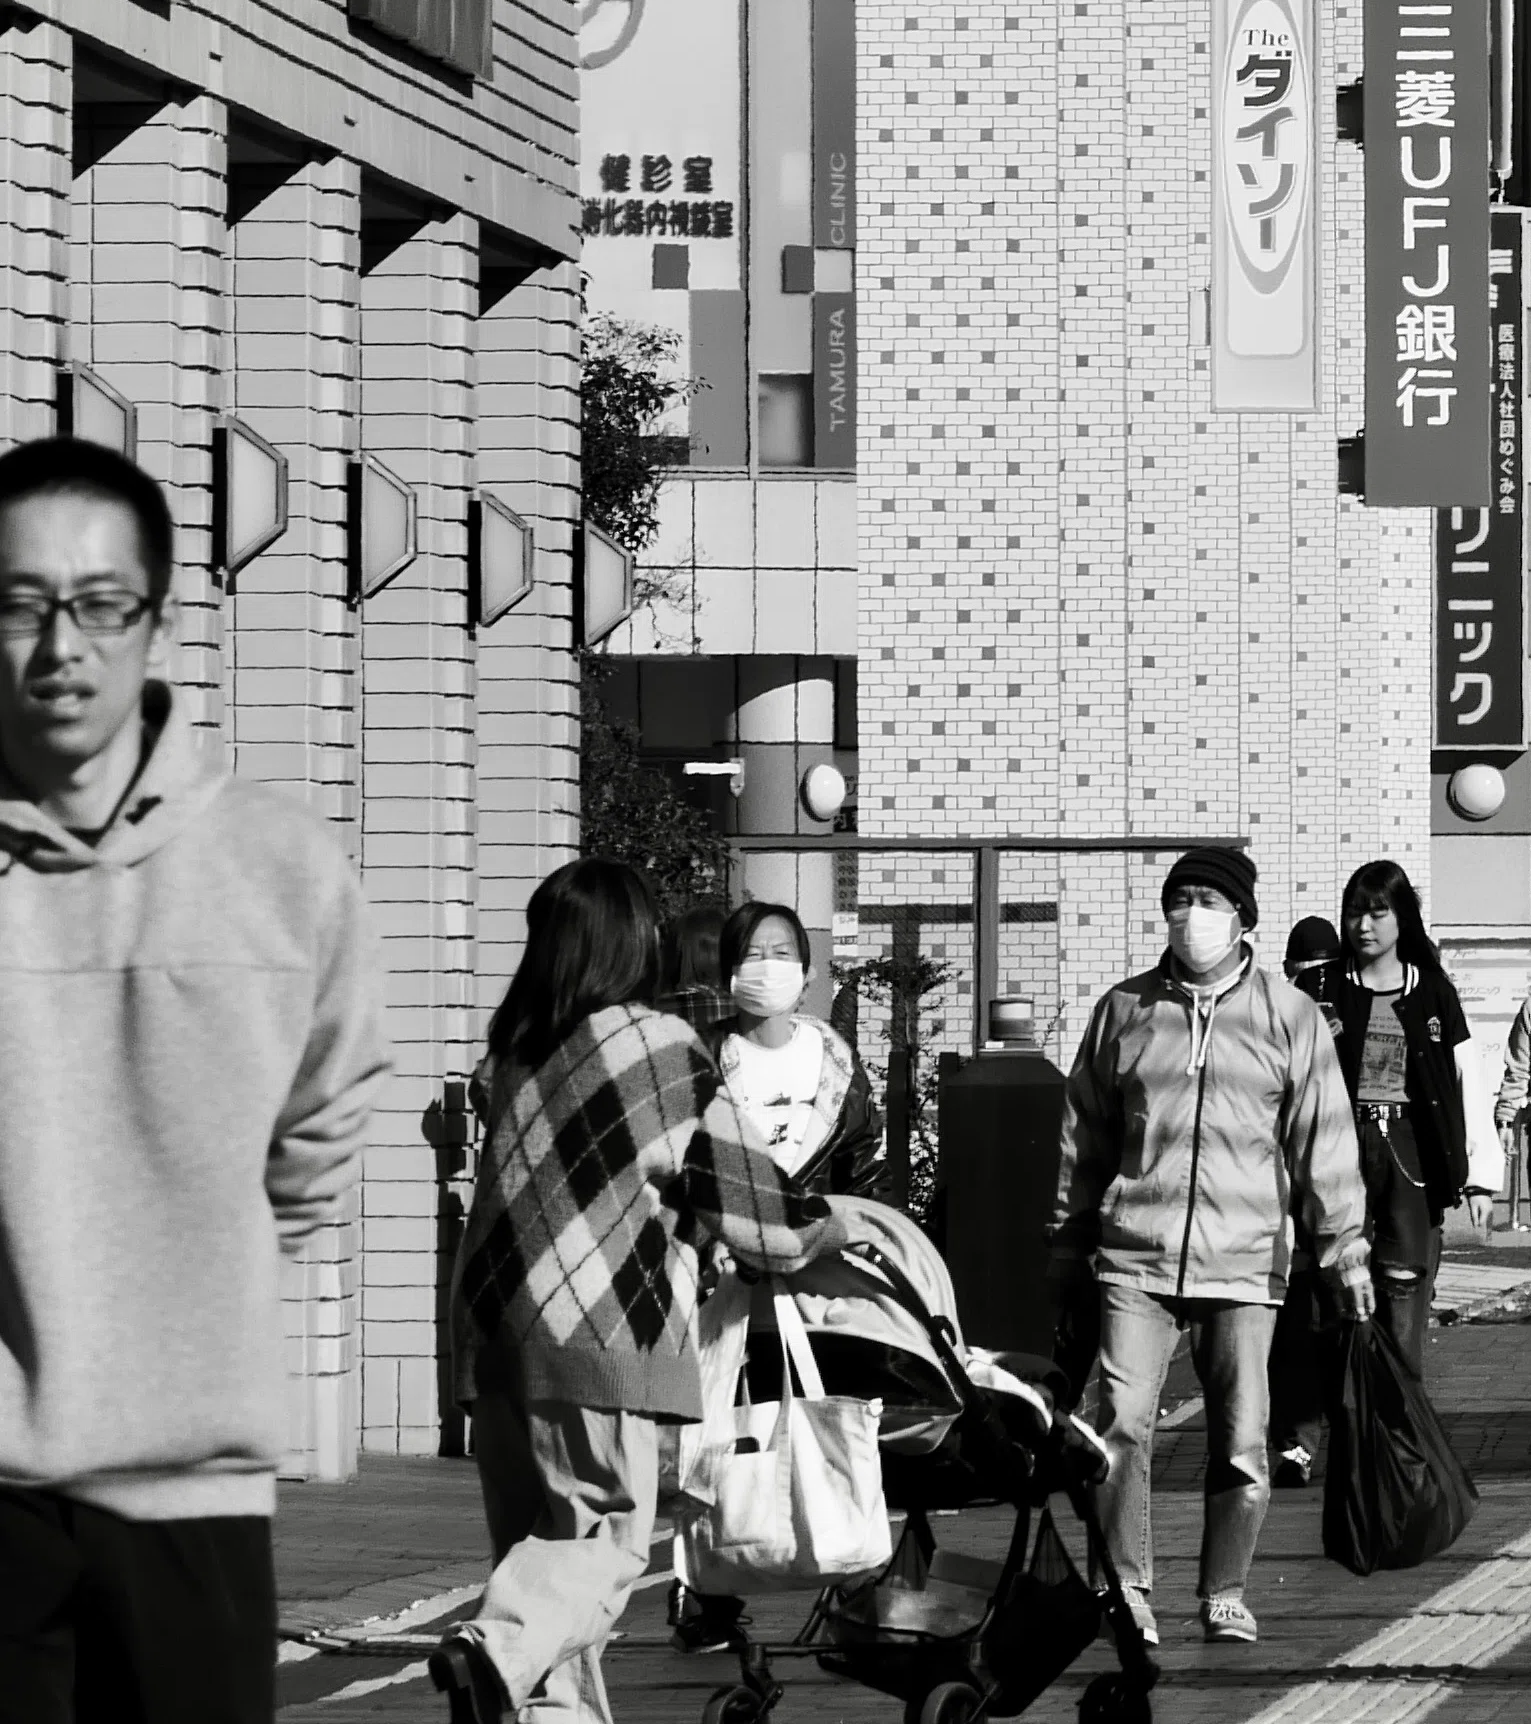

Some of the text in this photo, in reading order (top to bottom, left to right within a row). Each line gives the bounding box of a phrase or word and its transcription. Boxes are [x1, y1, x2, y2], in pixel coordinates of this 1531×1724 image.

[1242, 27, 1290, 48] The
[1236, 49, 1299, 253] ダイソー
[1395, 5, 1458, 428] 三菱UFJ銀行
[830, 151, 848, 434] TAMURA CLINIC
[1497, 323, 1516, 515] 医療法人社団めぐみ会
